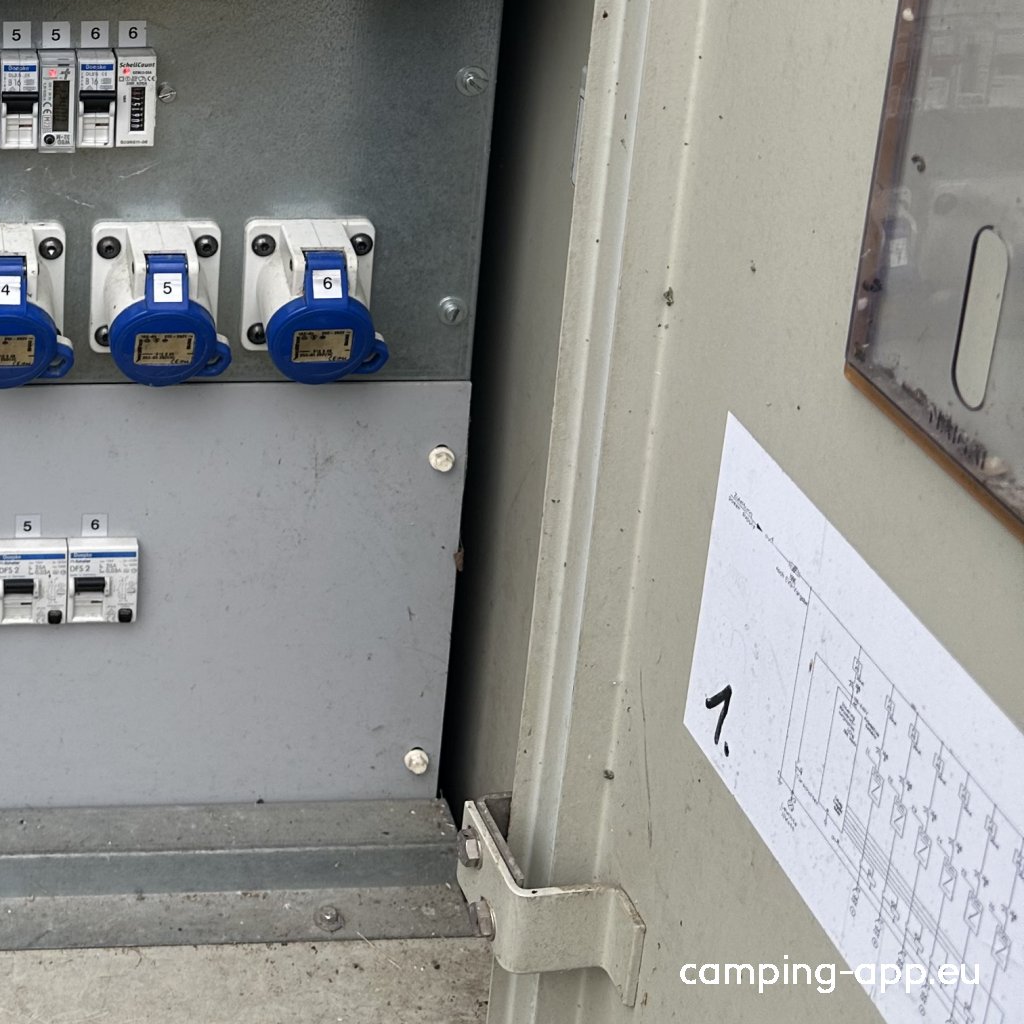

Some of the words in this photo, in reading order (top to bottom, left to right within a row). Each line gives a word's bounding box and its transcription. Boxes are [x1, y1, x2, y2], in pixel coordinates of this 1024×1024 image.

[11, 28, 22, 42] 5
[51, 28, 61, 42] 5
[90, 27, 101, 40] 6
[128, 26, 138, 40] 6
[0, 283, 11, 296] 4
[163, 281, 173, 295] 5
[323, 276, 333, 290] 6
[23, 520, 33, 532] 5
[90, 518, 100, 531] 6
